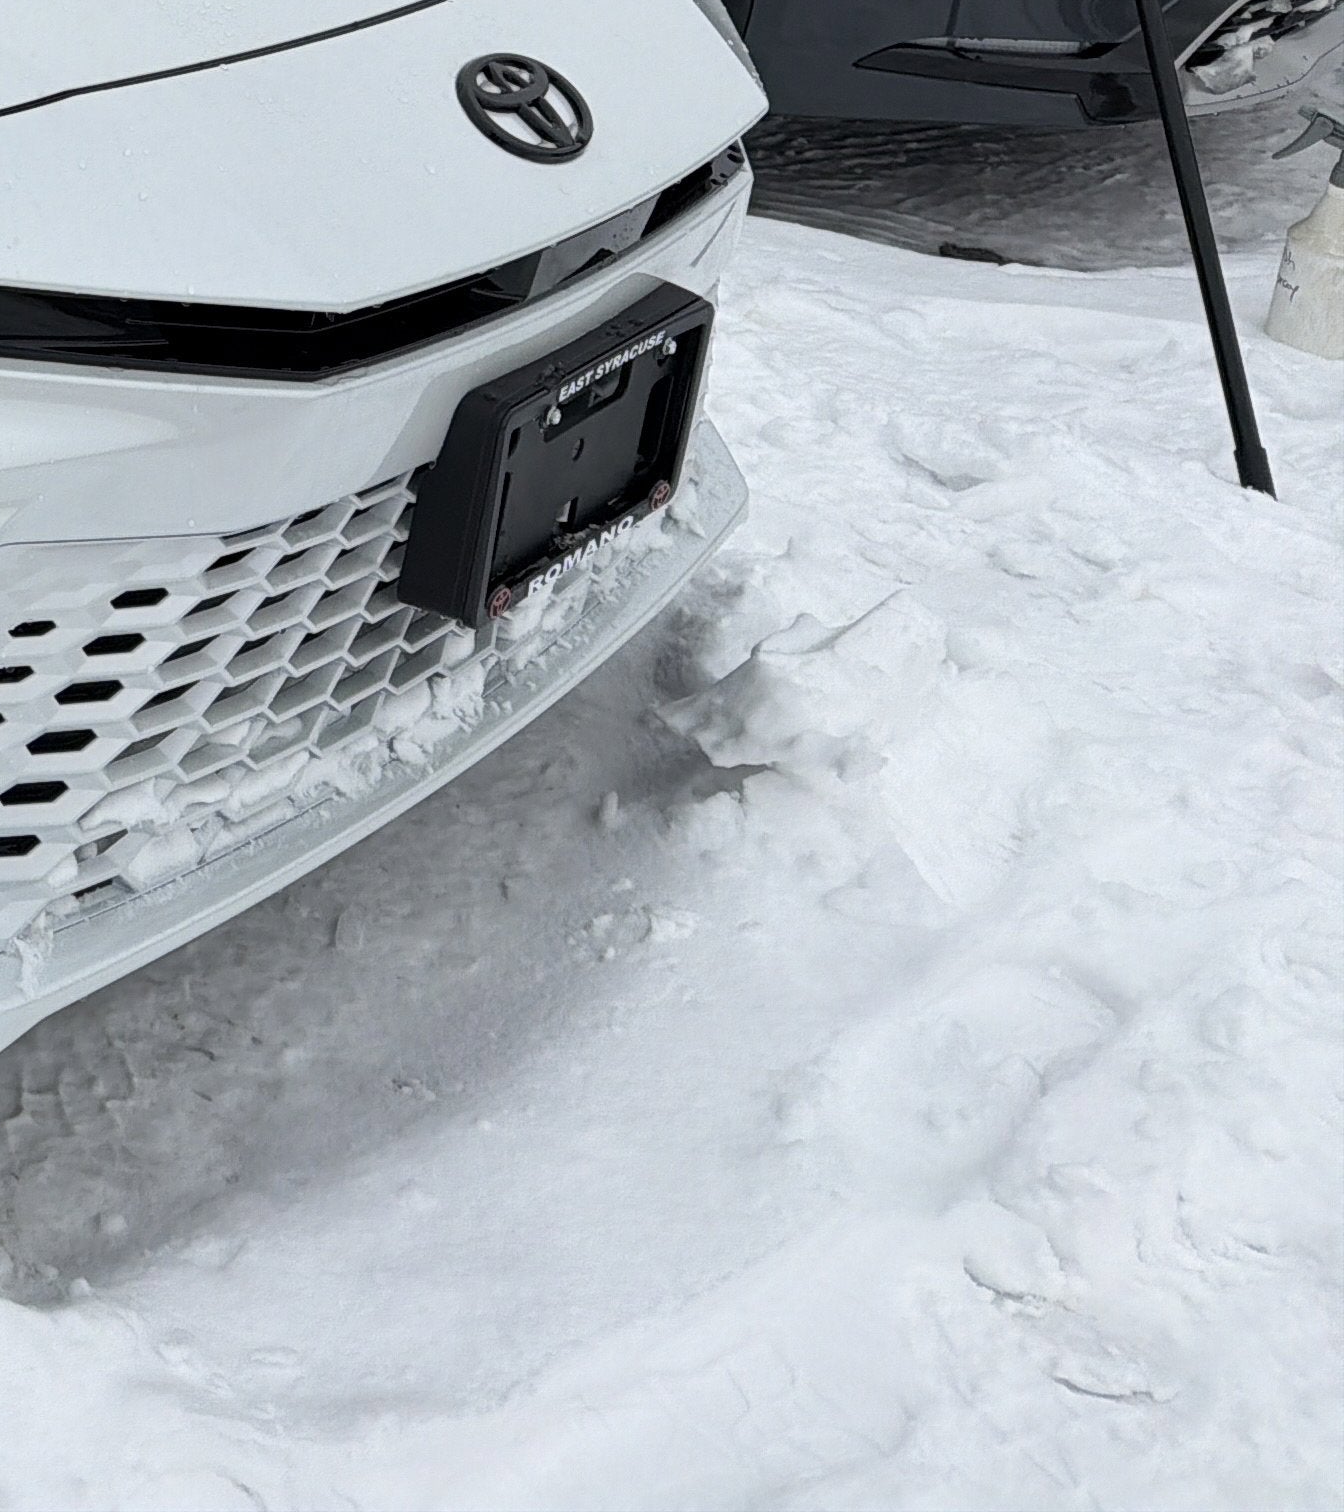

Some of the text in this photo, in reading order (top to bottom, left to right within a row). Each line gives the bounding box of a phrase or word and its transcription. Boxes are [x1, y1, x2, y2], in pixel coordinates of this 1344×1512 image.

[558, 330, 666, 403] EAST SYRACUSE
[528, 515, 634, 596] ROMANO
